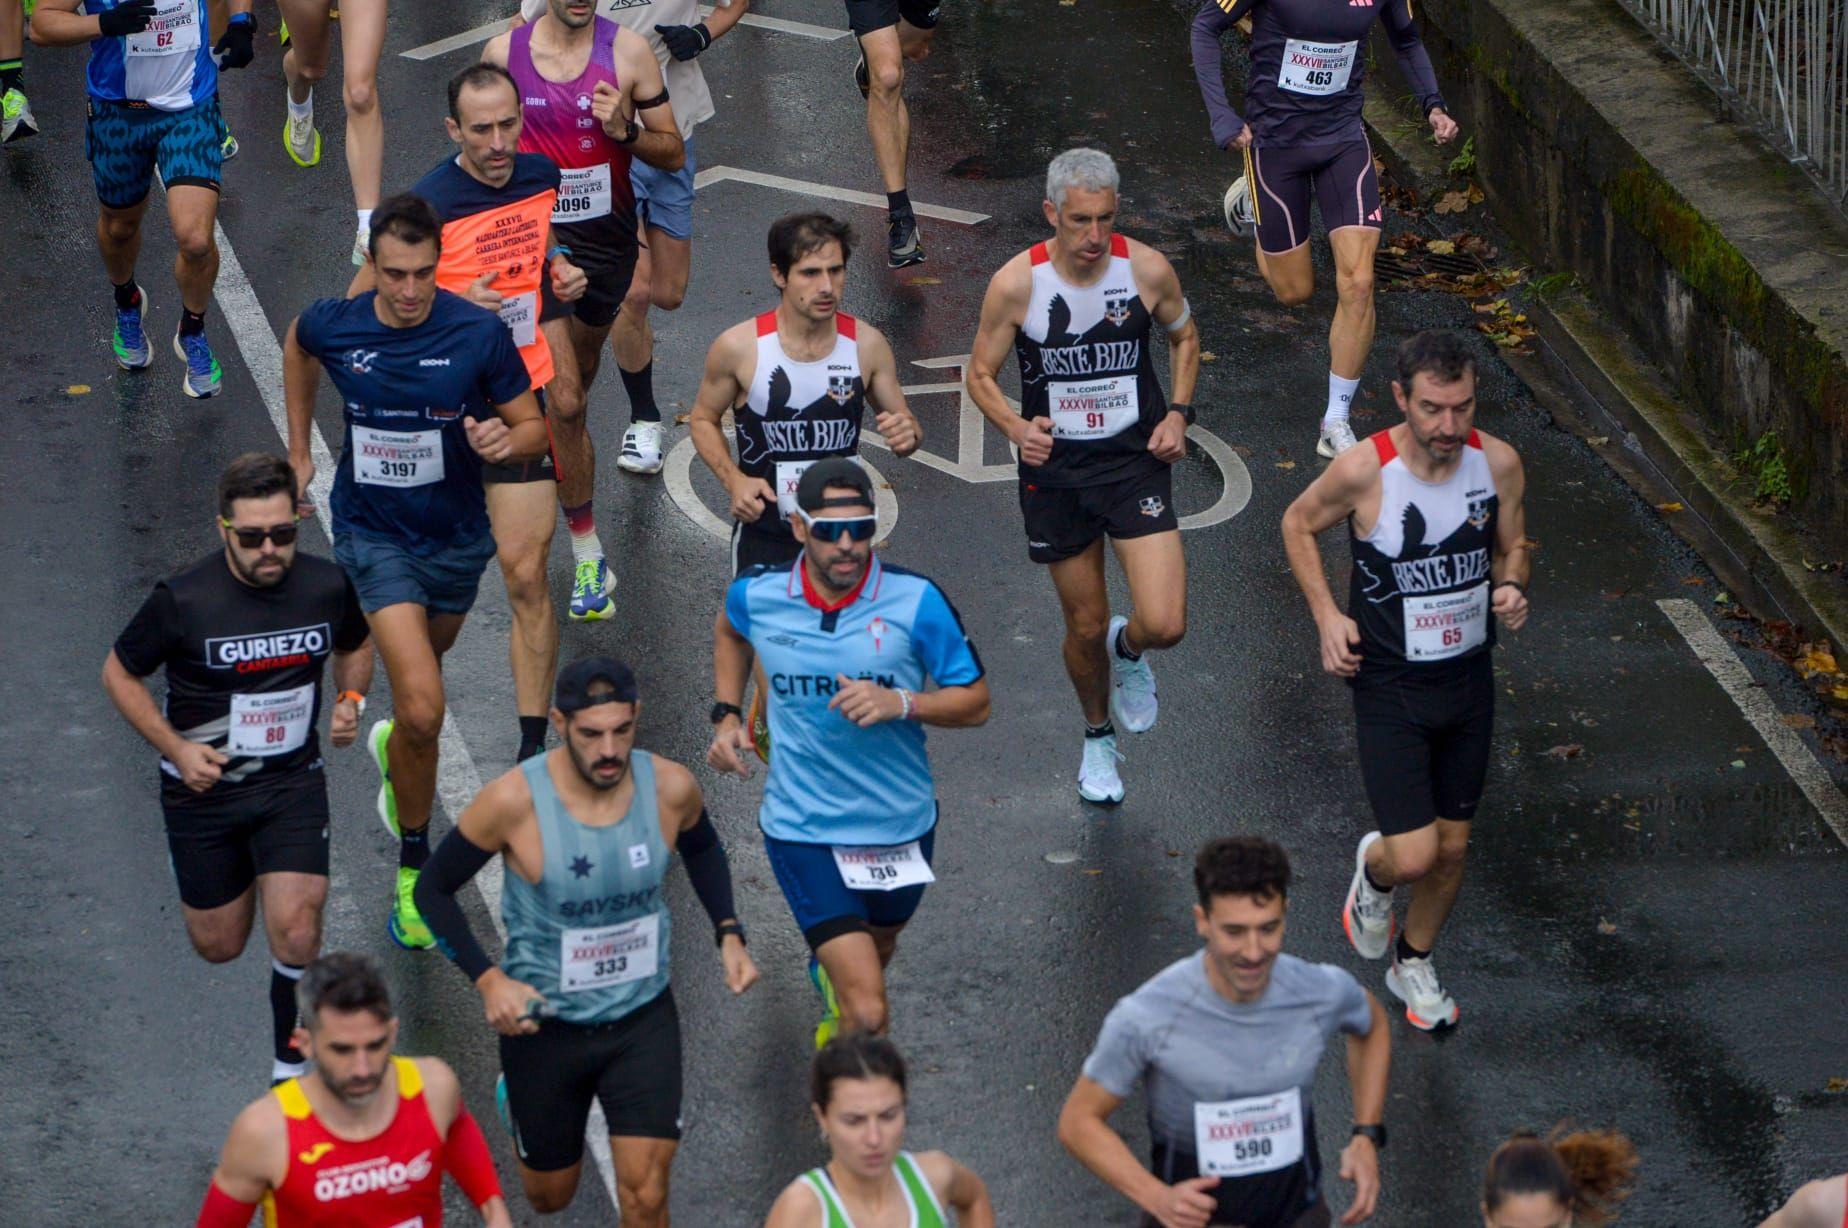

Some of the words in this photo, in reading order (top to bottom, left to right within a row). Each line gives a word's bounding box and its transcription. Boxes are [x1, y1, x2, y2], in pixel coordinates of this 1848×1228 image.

[158, 6, 182, 16] ORREO
[157, 31, 173, 47] 62
[1291, 53, 1323, 69] XXXVII
[1305, 71, 1333, 86] 463
[560, 172, 591, 181] ORREO
[1040, 344, 1092, 376] BESTE
[1093, 339, 1140, 373] BIRA
[1079, 384, 1116, 393] CORREO
[1059, 399, 1094, 410] XXXVII
[1095, 400, 1129, 409] BILBAO
[1086, 412, 1105, 428] 91
[810, 418, 857, 450] BIRA
[380, 460, 417, 477] 3197
[1391, 555, 1452, 593] BESTE
[1443, 627, 1462, 646] 65
[218, 630, 324, 664] GURIEZO
[265, 726, 285, 744] 80
[866, 865, 898, 880] 736
[559, 886, 659, 918] SAYSKY
[594, 956, 628, 977] 333
[1234, 1138, 1272, 1160] 590
[313, 1162, 408, 1202] OZONO
